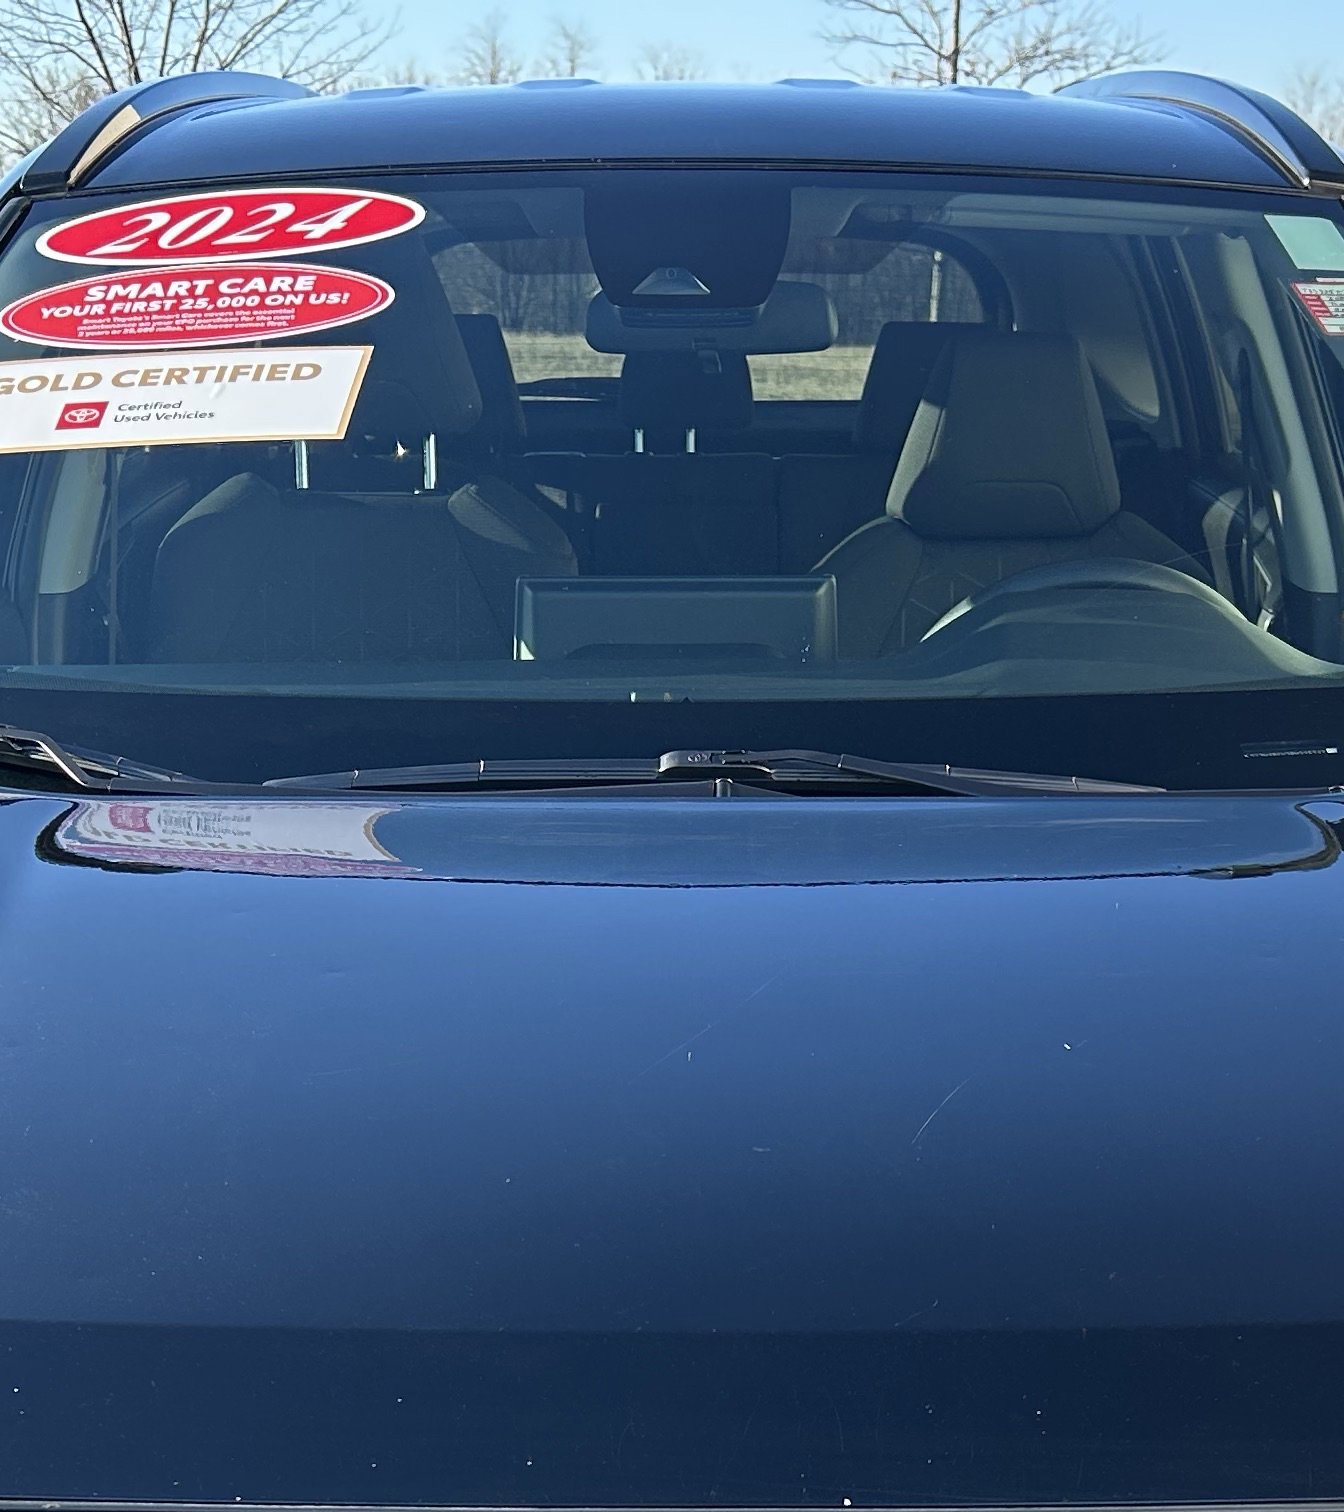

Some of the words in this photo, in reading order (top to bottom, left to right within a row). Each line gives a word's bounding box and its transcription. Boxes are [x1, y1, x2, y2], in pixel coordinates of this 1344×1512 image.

[86, 198, 375, 257] 2024
[83, 279, 215, 302] SMART
[218, 275, 318, 294] CARE
[40, 303, 107, 320] YOUR
[109, 299, 177, 315] FIRST
[179, 295, 261, 311] 25,000
[264, 293, 305, 307] ON
[308, 292, 351, 305] US!
[111, 362, 323, 389] CERTIFIED
[113, 412, 154, 423] Used
[155, 410, 216, 422] Vehicles
[117, 400, 183, 412] Certified
